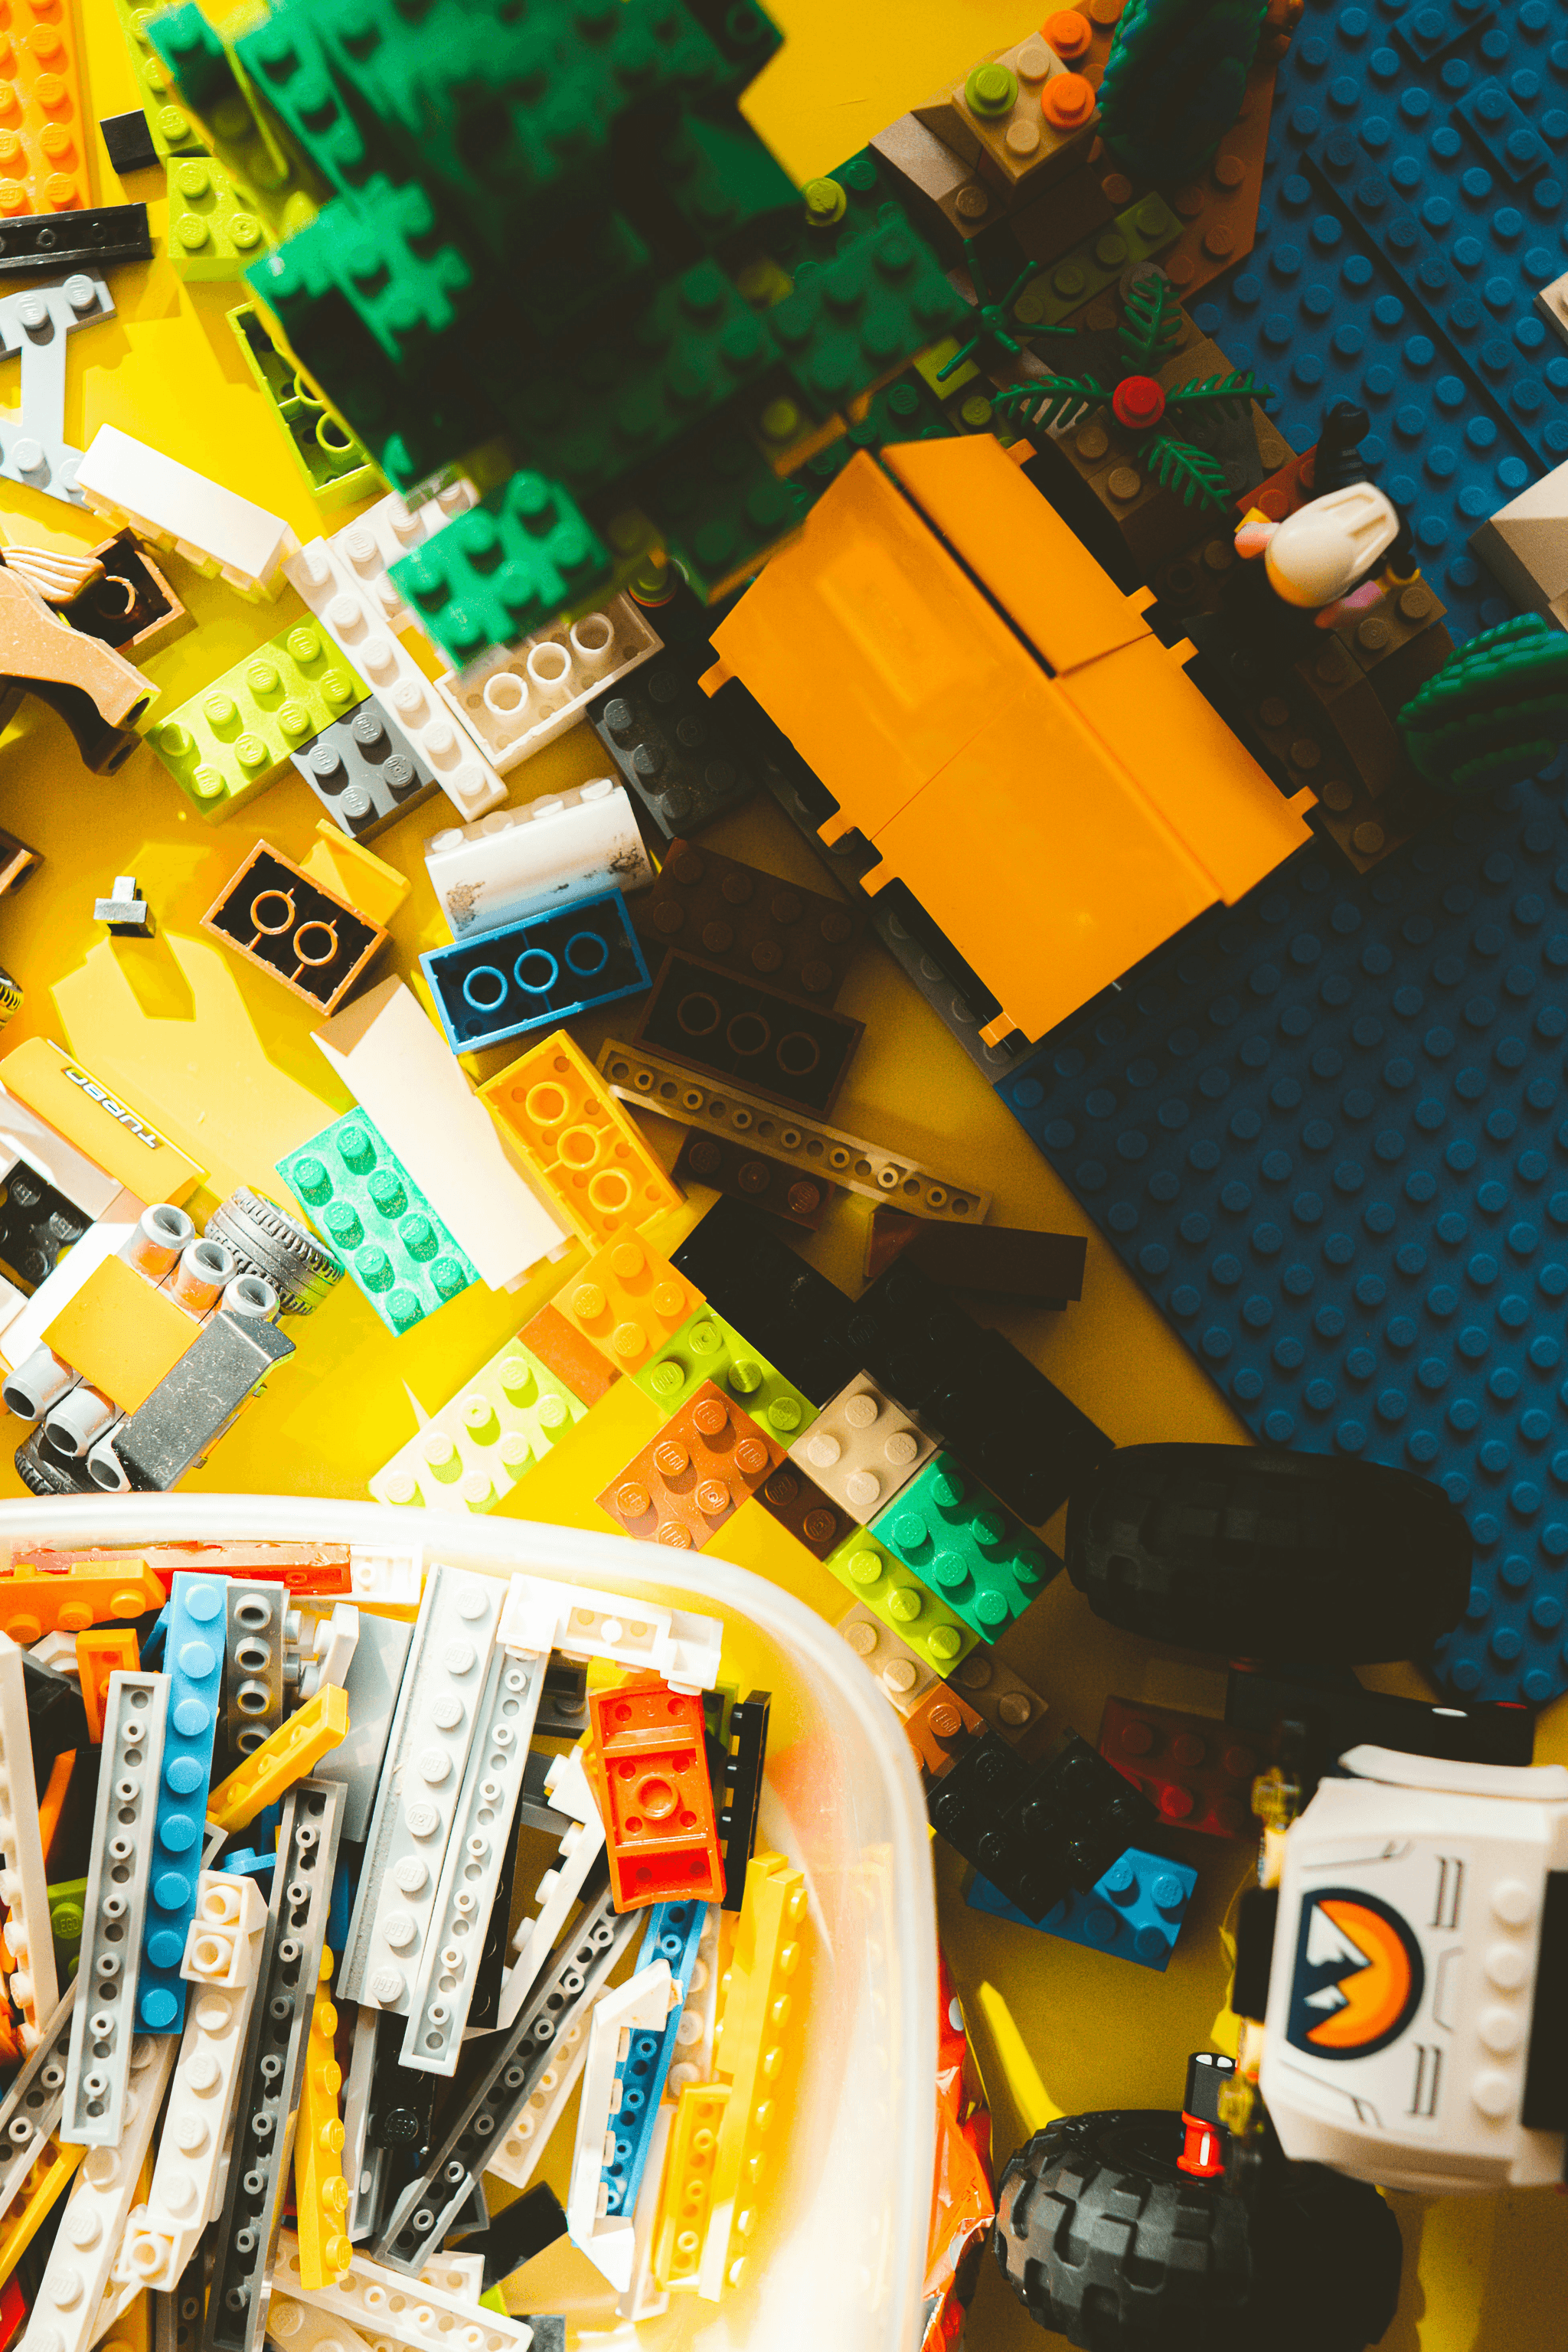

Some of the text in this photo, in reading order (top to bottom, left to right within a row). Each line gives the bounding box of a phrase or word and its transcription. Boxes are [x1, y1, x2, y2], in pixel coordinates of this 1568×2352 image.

[64, 1067, 156, 1149] TURBO
[931, 1709, 957, 1732] LEGO
[54, 1916, 79, 1934] LEGO
